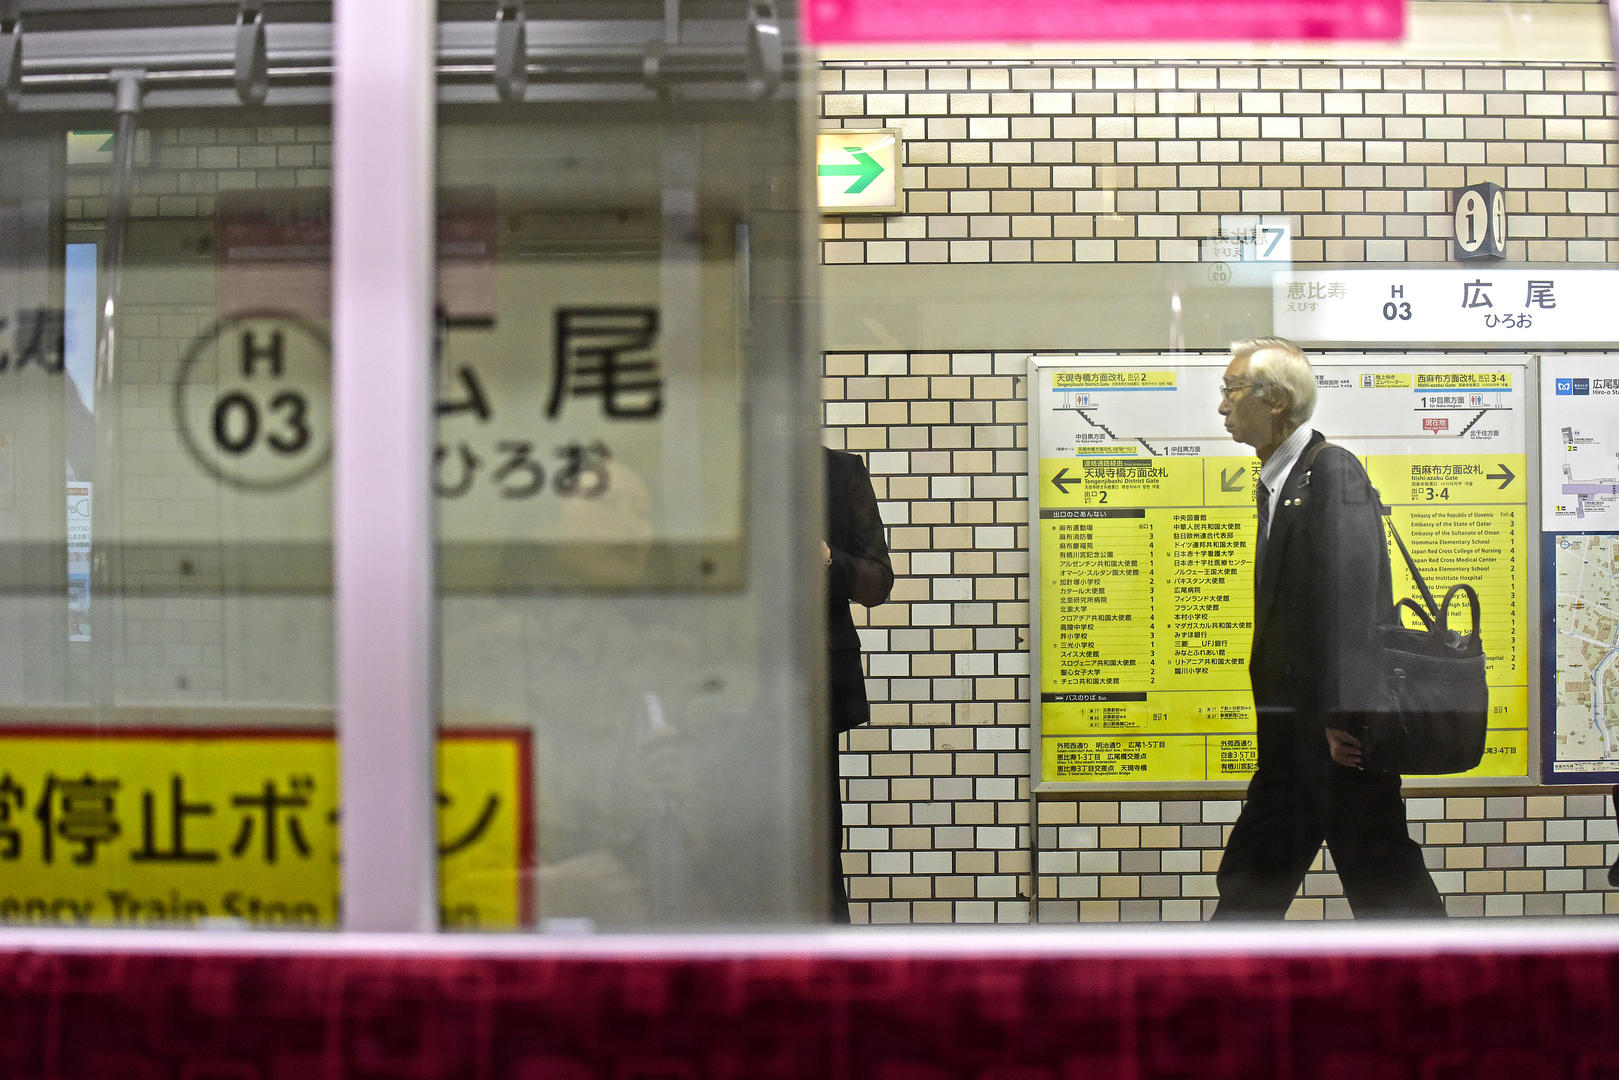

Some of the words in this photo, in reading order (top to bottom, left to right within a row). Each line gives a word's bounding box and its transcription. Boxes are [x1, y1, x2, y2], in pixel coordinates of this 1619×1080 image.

[1262, 228, 1284, 257] 7
[1287, 281, 1346, 300] 恵比寿
[1391, 285, 1403, 298] H
[1287, 302, 1318, 312] えびす
[1383, 302, 1412, 321] 03
[1484, 312, 1532, 328] ひろお
[241, 330, 284, 378] H
[1057, 373, 1125, 382] 天現寺橋方面改札
[1418, 374, 1476, 382] 西麻布方面改札
[1421, 397, 1426, 407] 1
[212, 391, 311, 456] 03
[434, 441, 611, 499] ひろお
[1085, 468, 1169, 478] 天現寺橋方面改札
[1412, 464, 1483, 475] 西麻布方面改札
[1099, 491, 1107, 503] 2
